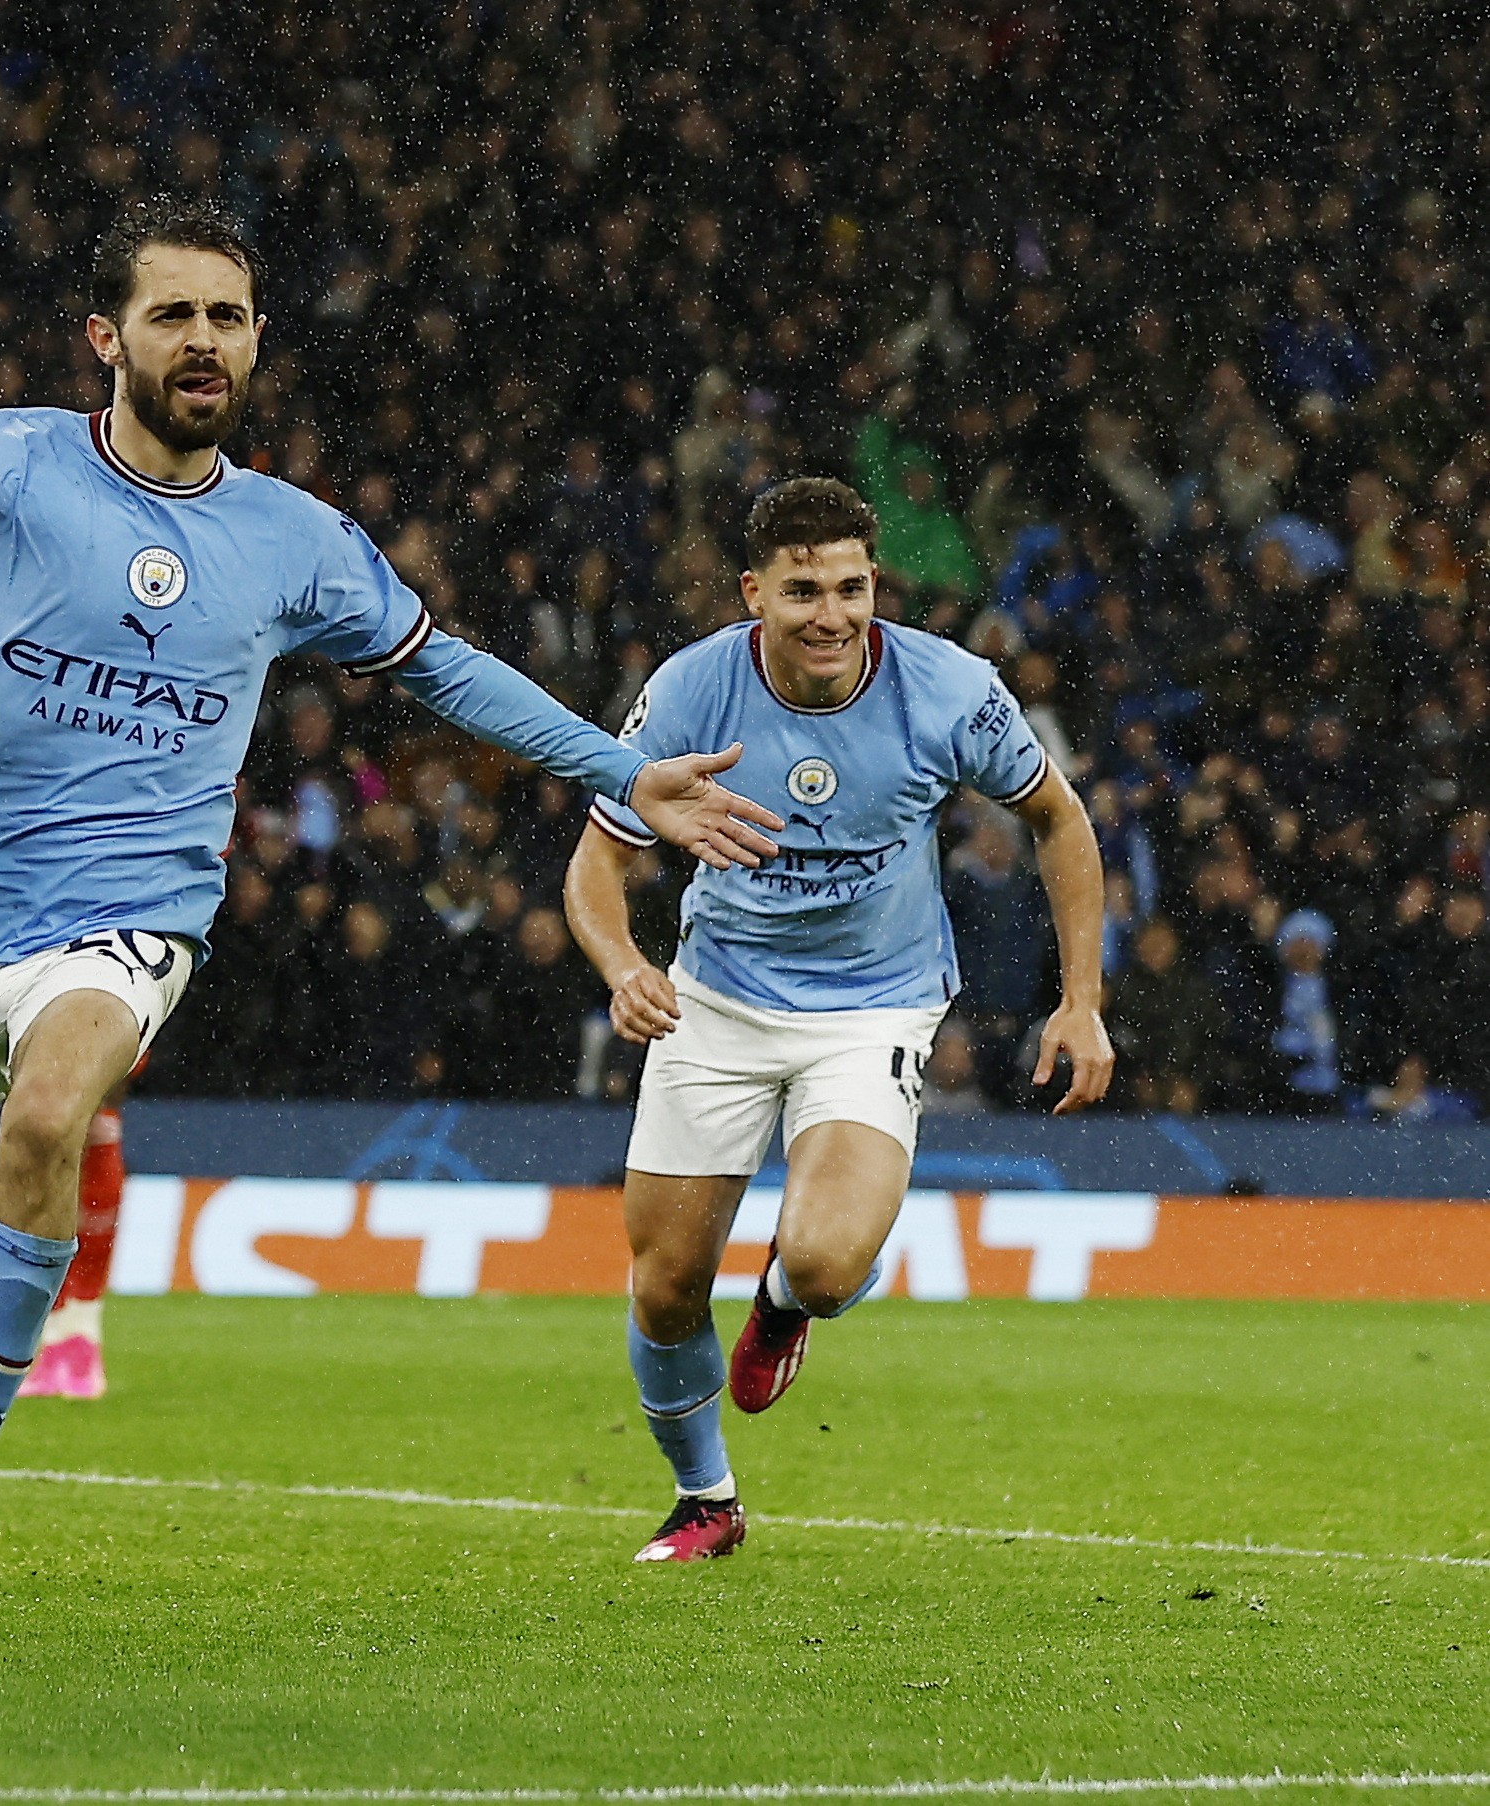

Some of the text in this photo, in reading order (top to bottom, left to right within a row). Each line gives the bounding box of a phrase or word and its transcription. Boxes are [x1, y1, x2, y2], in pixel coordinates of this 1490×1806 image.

[135, 550, 183, 575] MANCHESTER
[143, 596, 162, 605] CITY
[1, 638, 229, 726] ETIHAD
[28, 696, 187, 755] AIRWAYS
